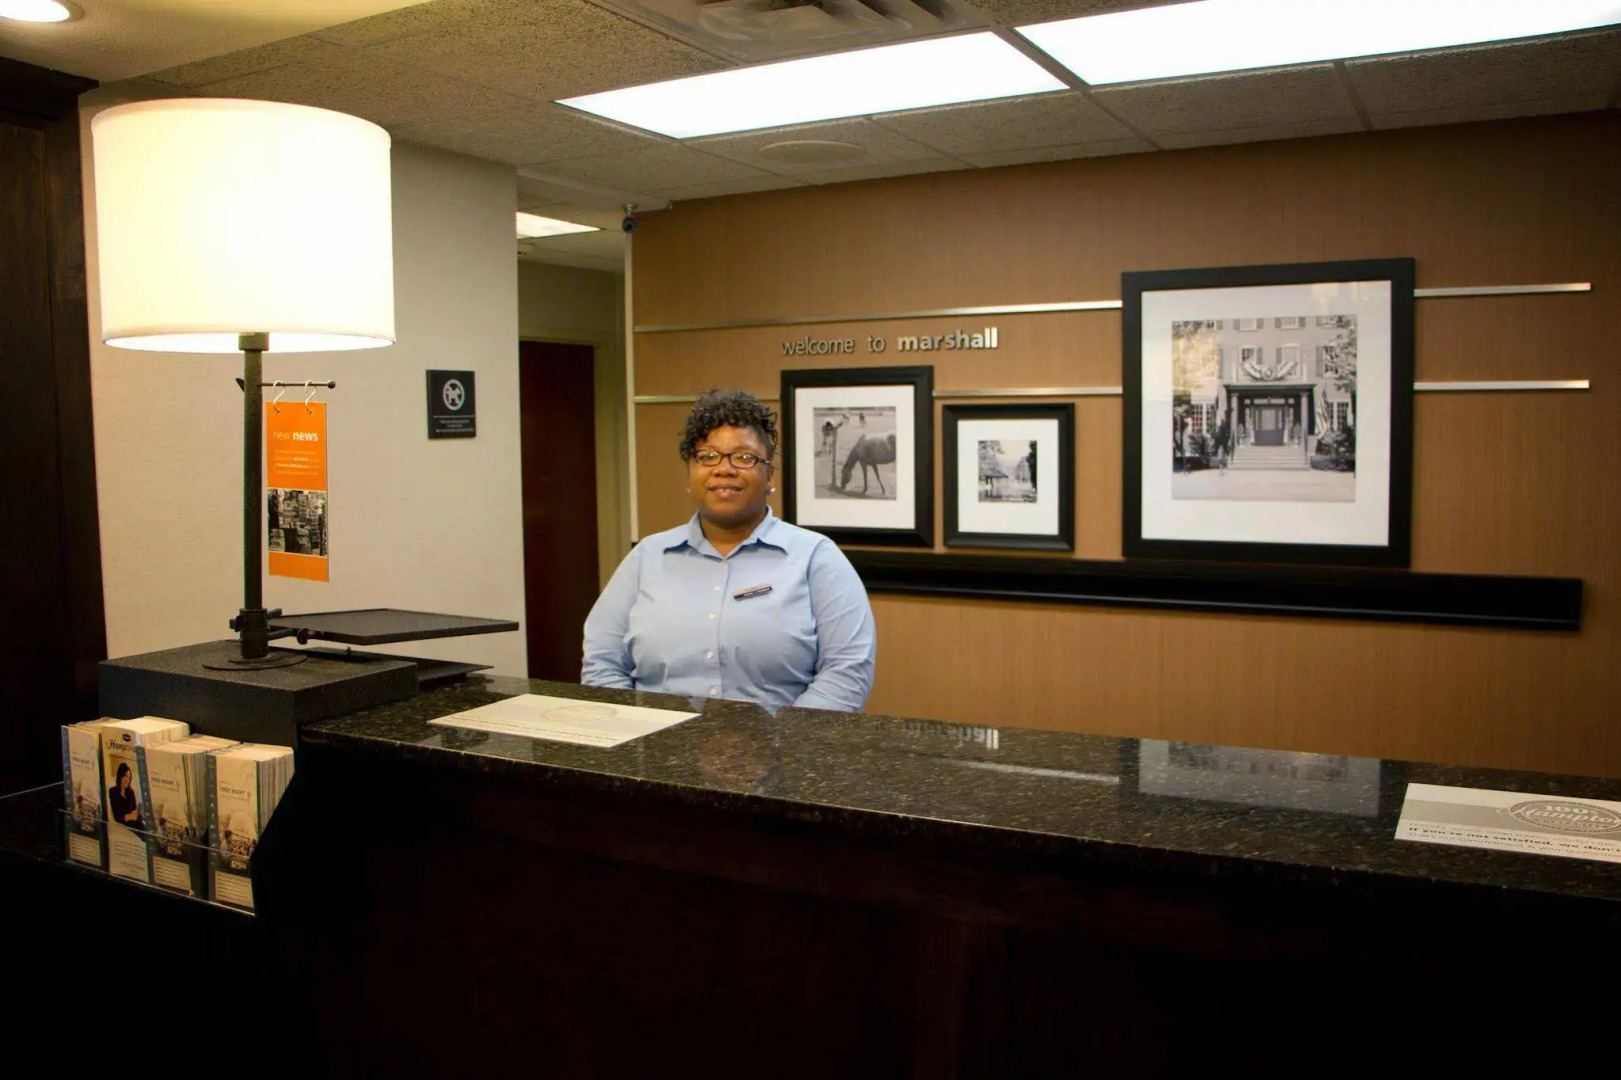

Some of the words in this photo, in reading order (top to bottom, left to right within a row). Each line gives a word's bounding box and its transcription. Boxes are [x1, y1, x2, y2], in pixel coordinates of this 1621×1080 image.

[781, 336, 855, 356] welcome
[867, 335, 886, 352] to
[897, 327, 999, 351] marshall
[272, 431, 290, 441] new
[292, 431, 319, 442] news
[1493, 836, 1554, 845] satisfied,
